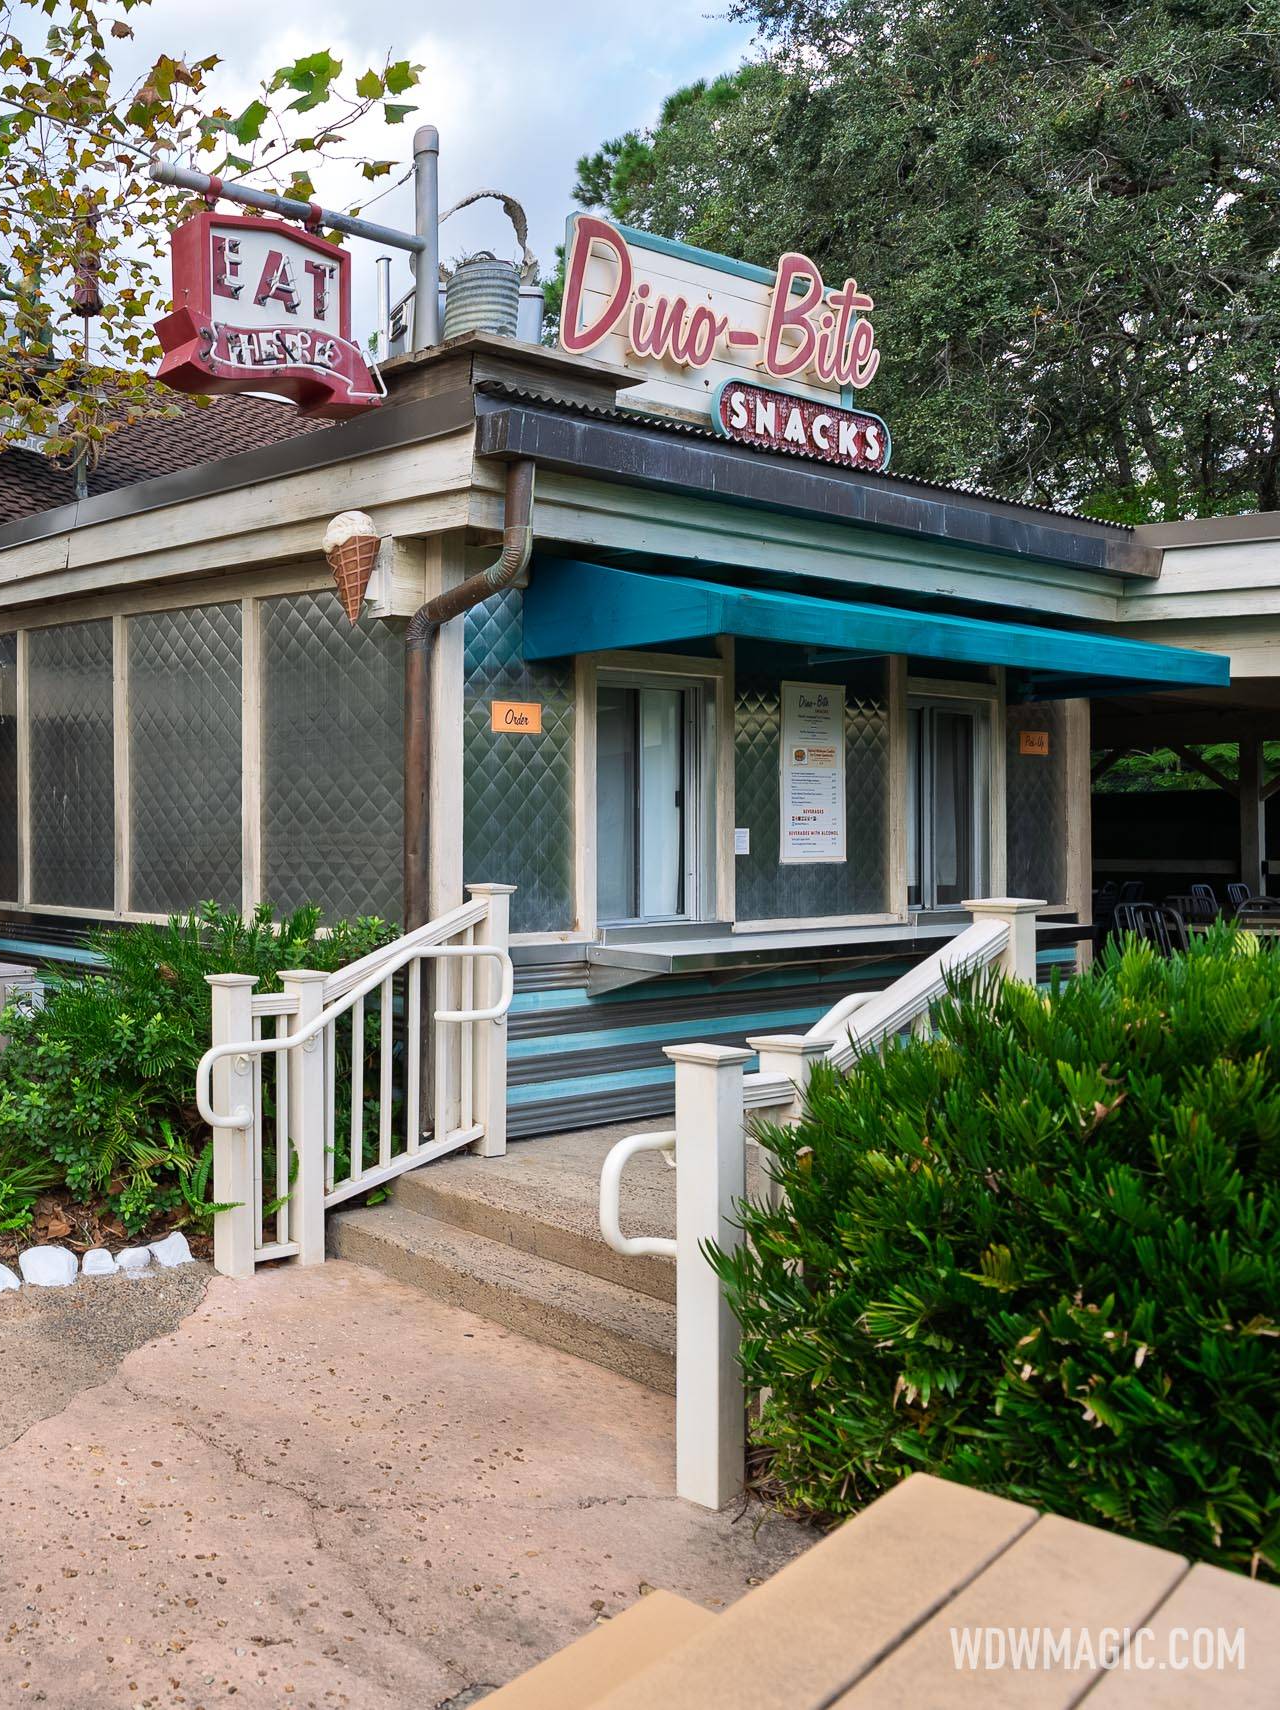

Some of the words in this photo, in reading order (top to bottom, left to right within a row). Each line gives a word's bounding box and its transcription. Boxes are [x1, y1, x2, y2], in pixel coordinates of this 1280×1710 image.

[212, 234, 338, 321] EAT
[560, 215, 880, 389] Dino-Bite
[226, 331, 336, 369] HERE
[729, 391, 880, 461] SNACKS
[505, 709, 529, 725] Order
